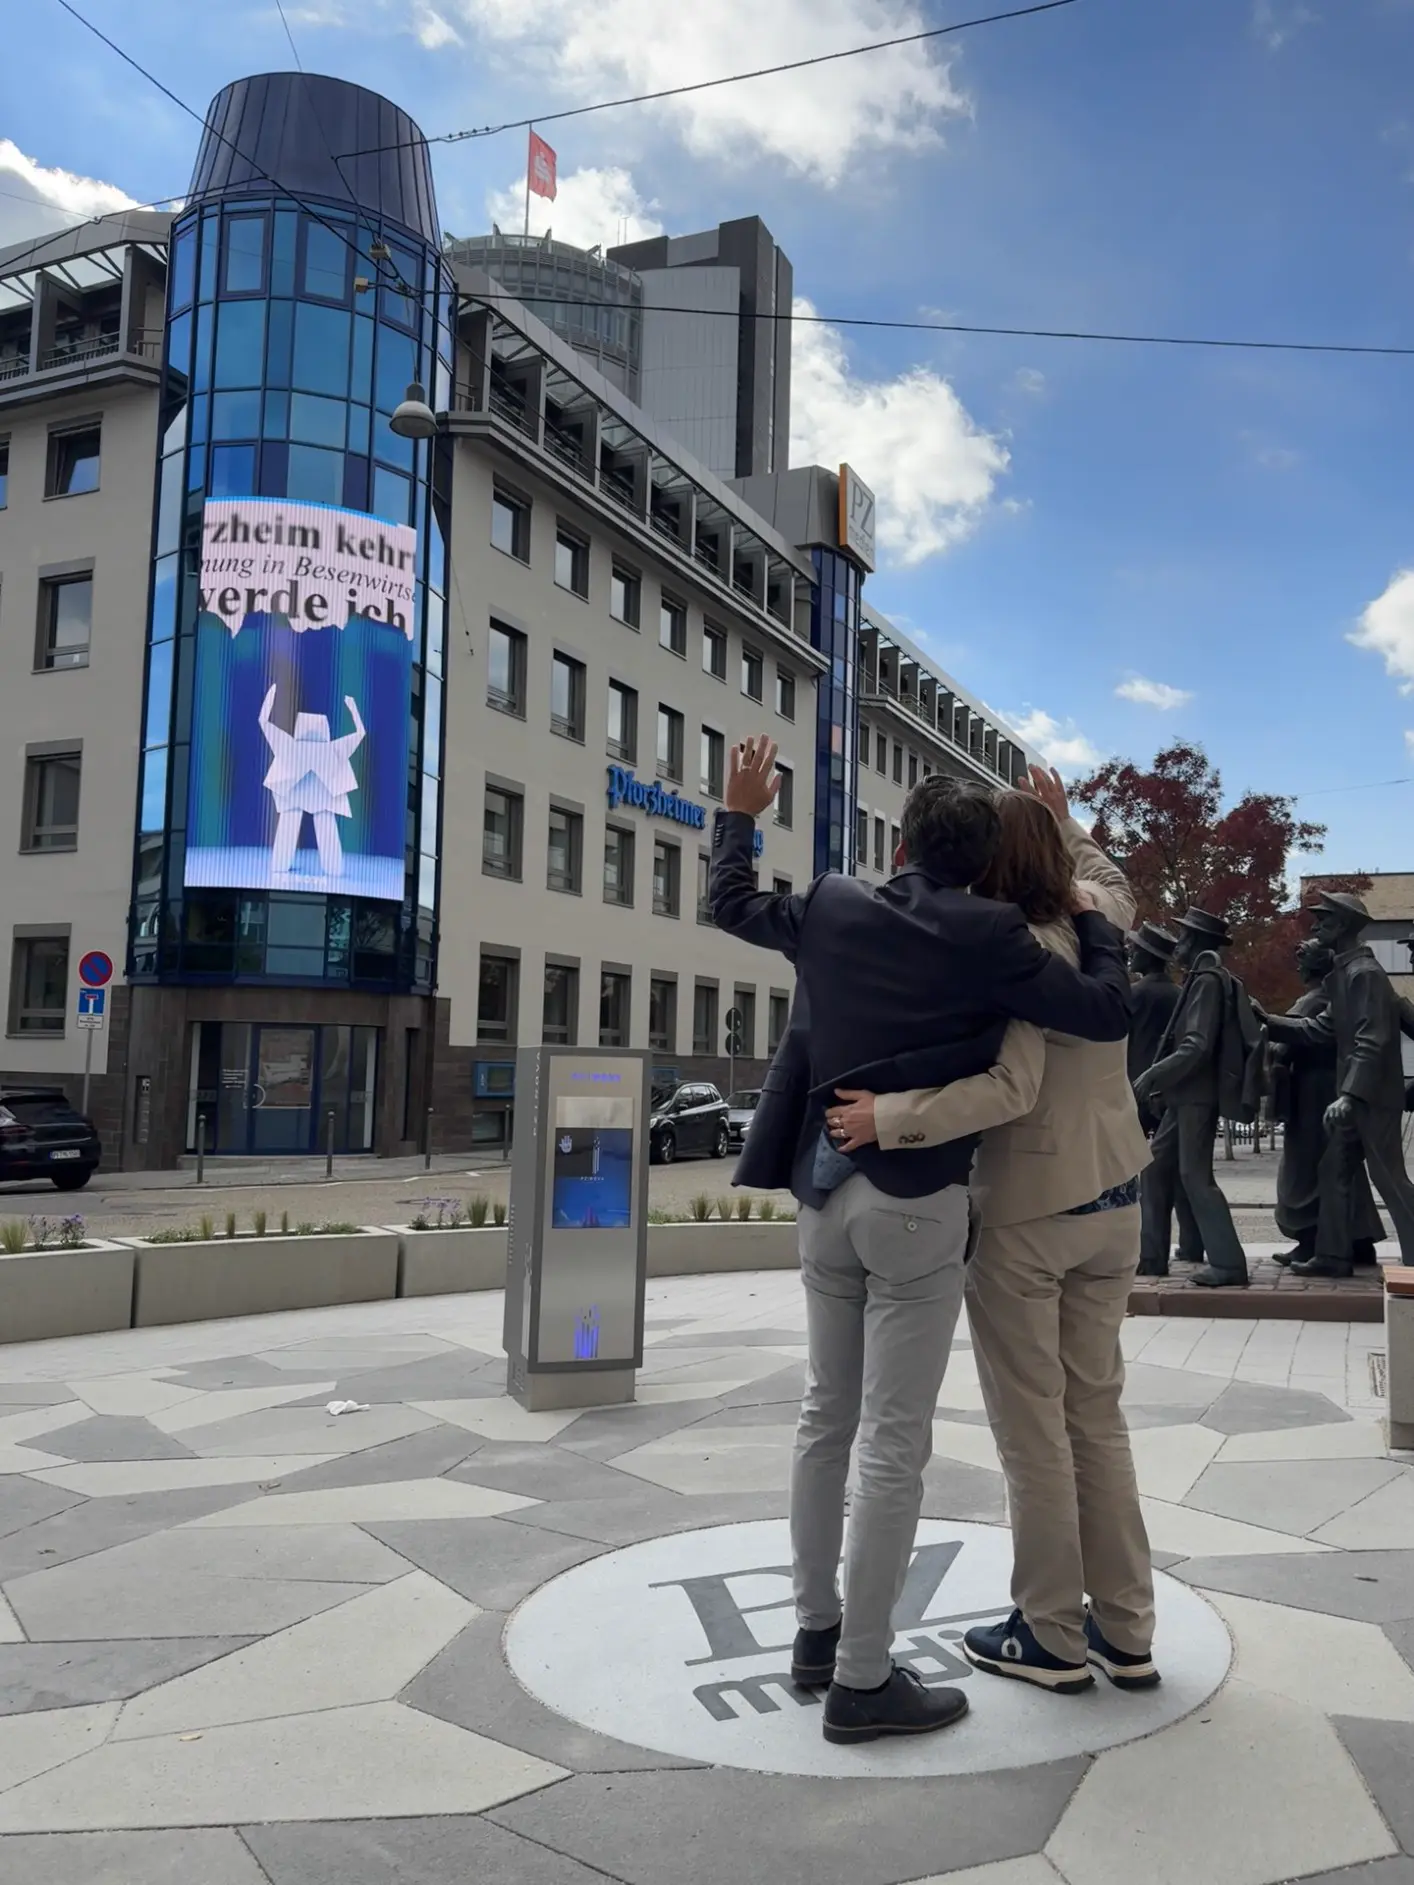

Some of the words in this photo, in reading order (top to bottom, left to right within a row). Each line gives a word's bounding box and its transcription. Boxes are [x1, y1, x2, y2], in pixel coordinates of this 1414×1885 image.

[850, 479, 874, 540] PZ
[262, 554, 285, 575] in
[337, 519, 416, 573] kehr
[606, 763, 706, 830] Pforzheimer
